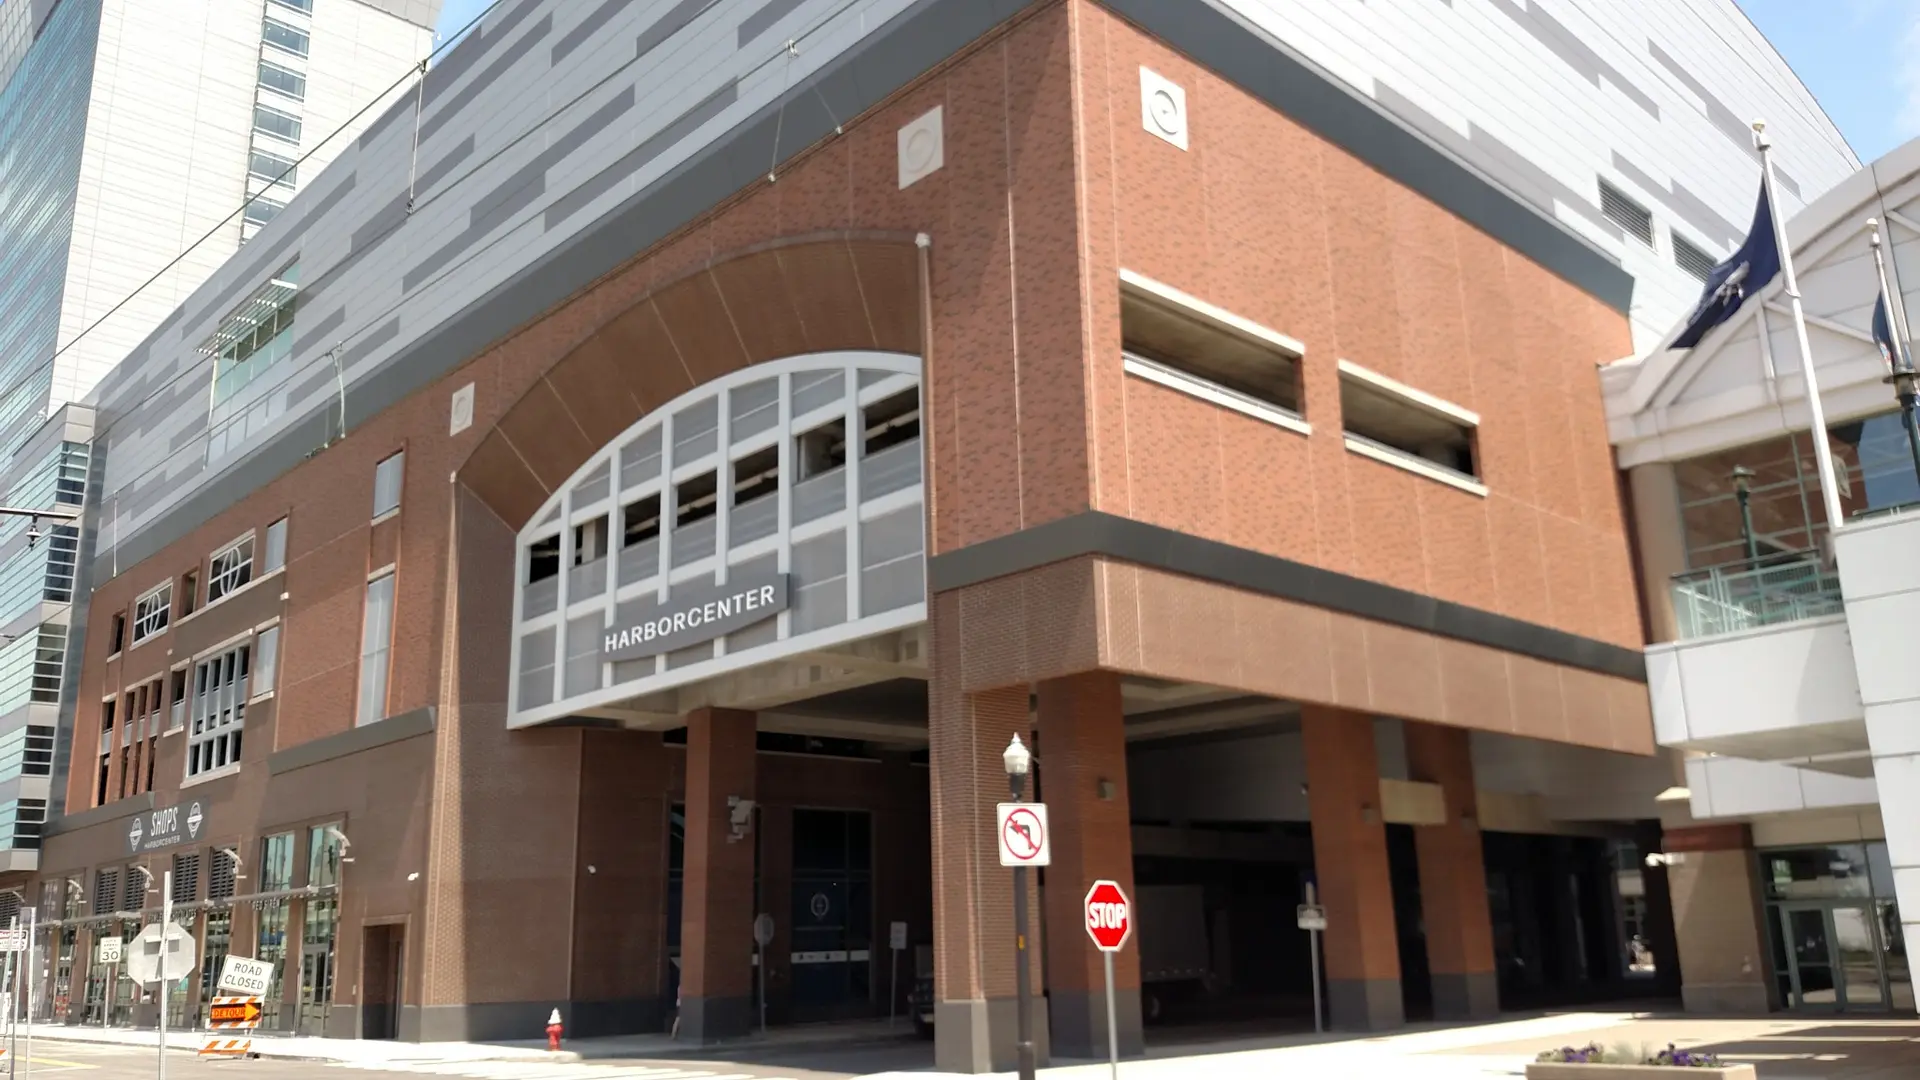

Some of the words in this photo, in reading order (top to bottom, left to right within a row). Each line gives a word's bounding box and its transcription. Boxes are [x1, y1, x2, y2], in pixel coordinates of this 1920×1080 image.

[604, 584, 776, 653] HARBORCENTER
[150, 806, 178, 836] SHOPS
[1088, 902, 1126, 929] STOP
[102, 951, 119, 961] 30
[234, 962, 263, 976] ROAD
[224, 974, 264, 990] CLOSED
[214, 1008, 246, 1018] DETOUR
